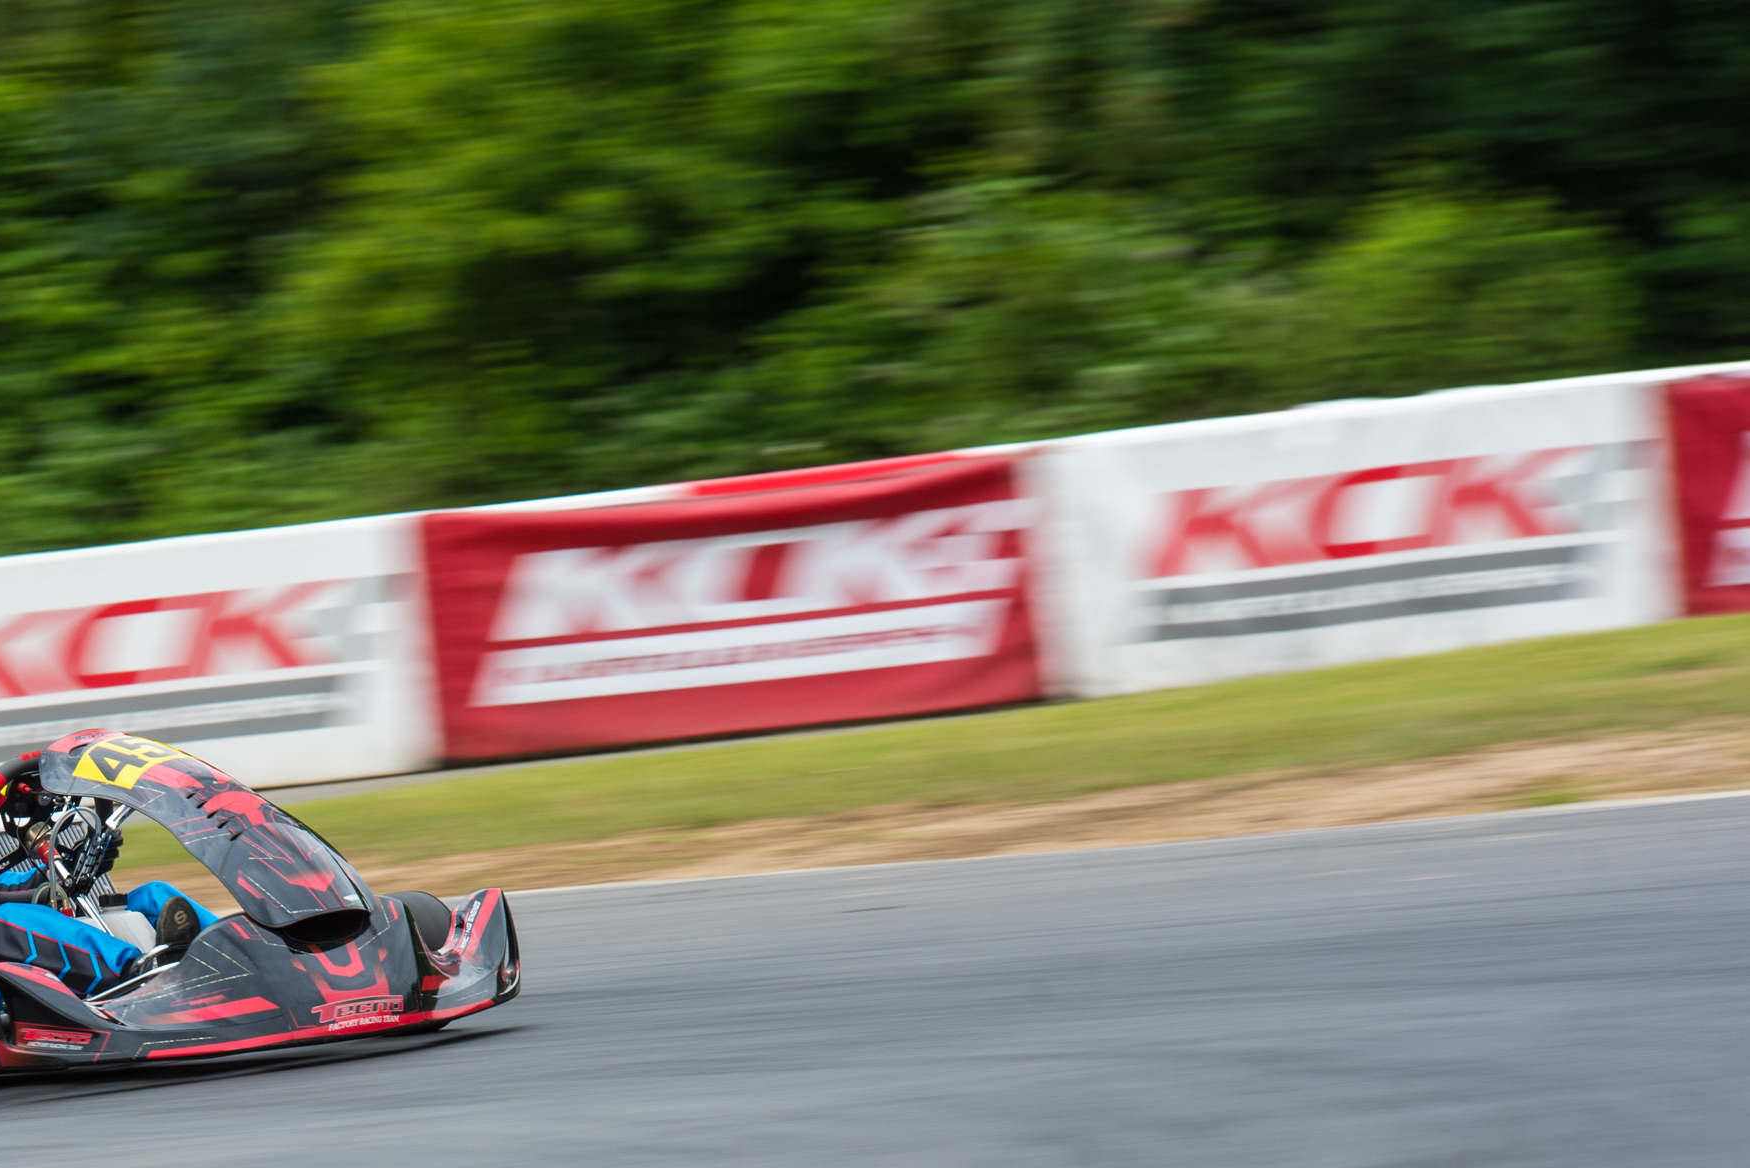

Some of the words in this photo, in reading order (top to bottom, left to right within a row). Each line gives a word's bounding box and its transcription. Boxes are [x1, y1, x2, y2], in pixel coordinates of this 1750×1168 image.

[1137, 446, 1595, 578] KCK
[328, 1019, 358, 1031] FACTORY
[358, 1015, 382, 1026] RACING
[382, 1014, 400, 1023] TEAM
